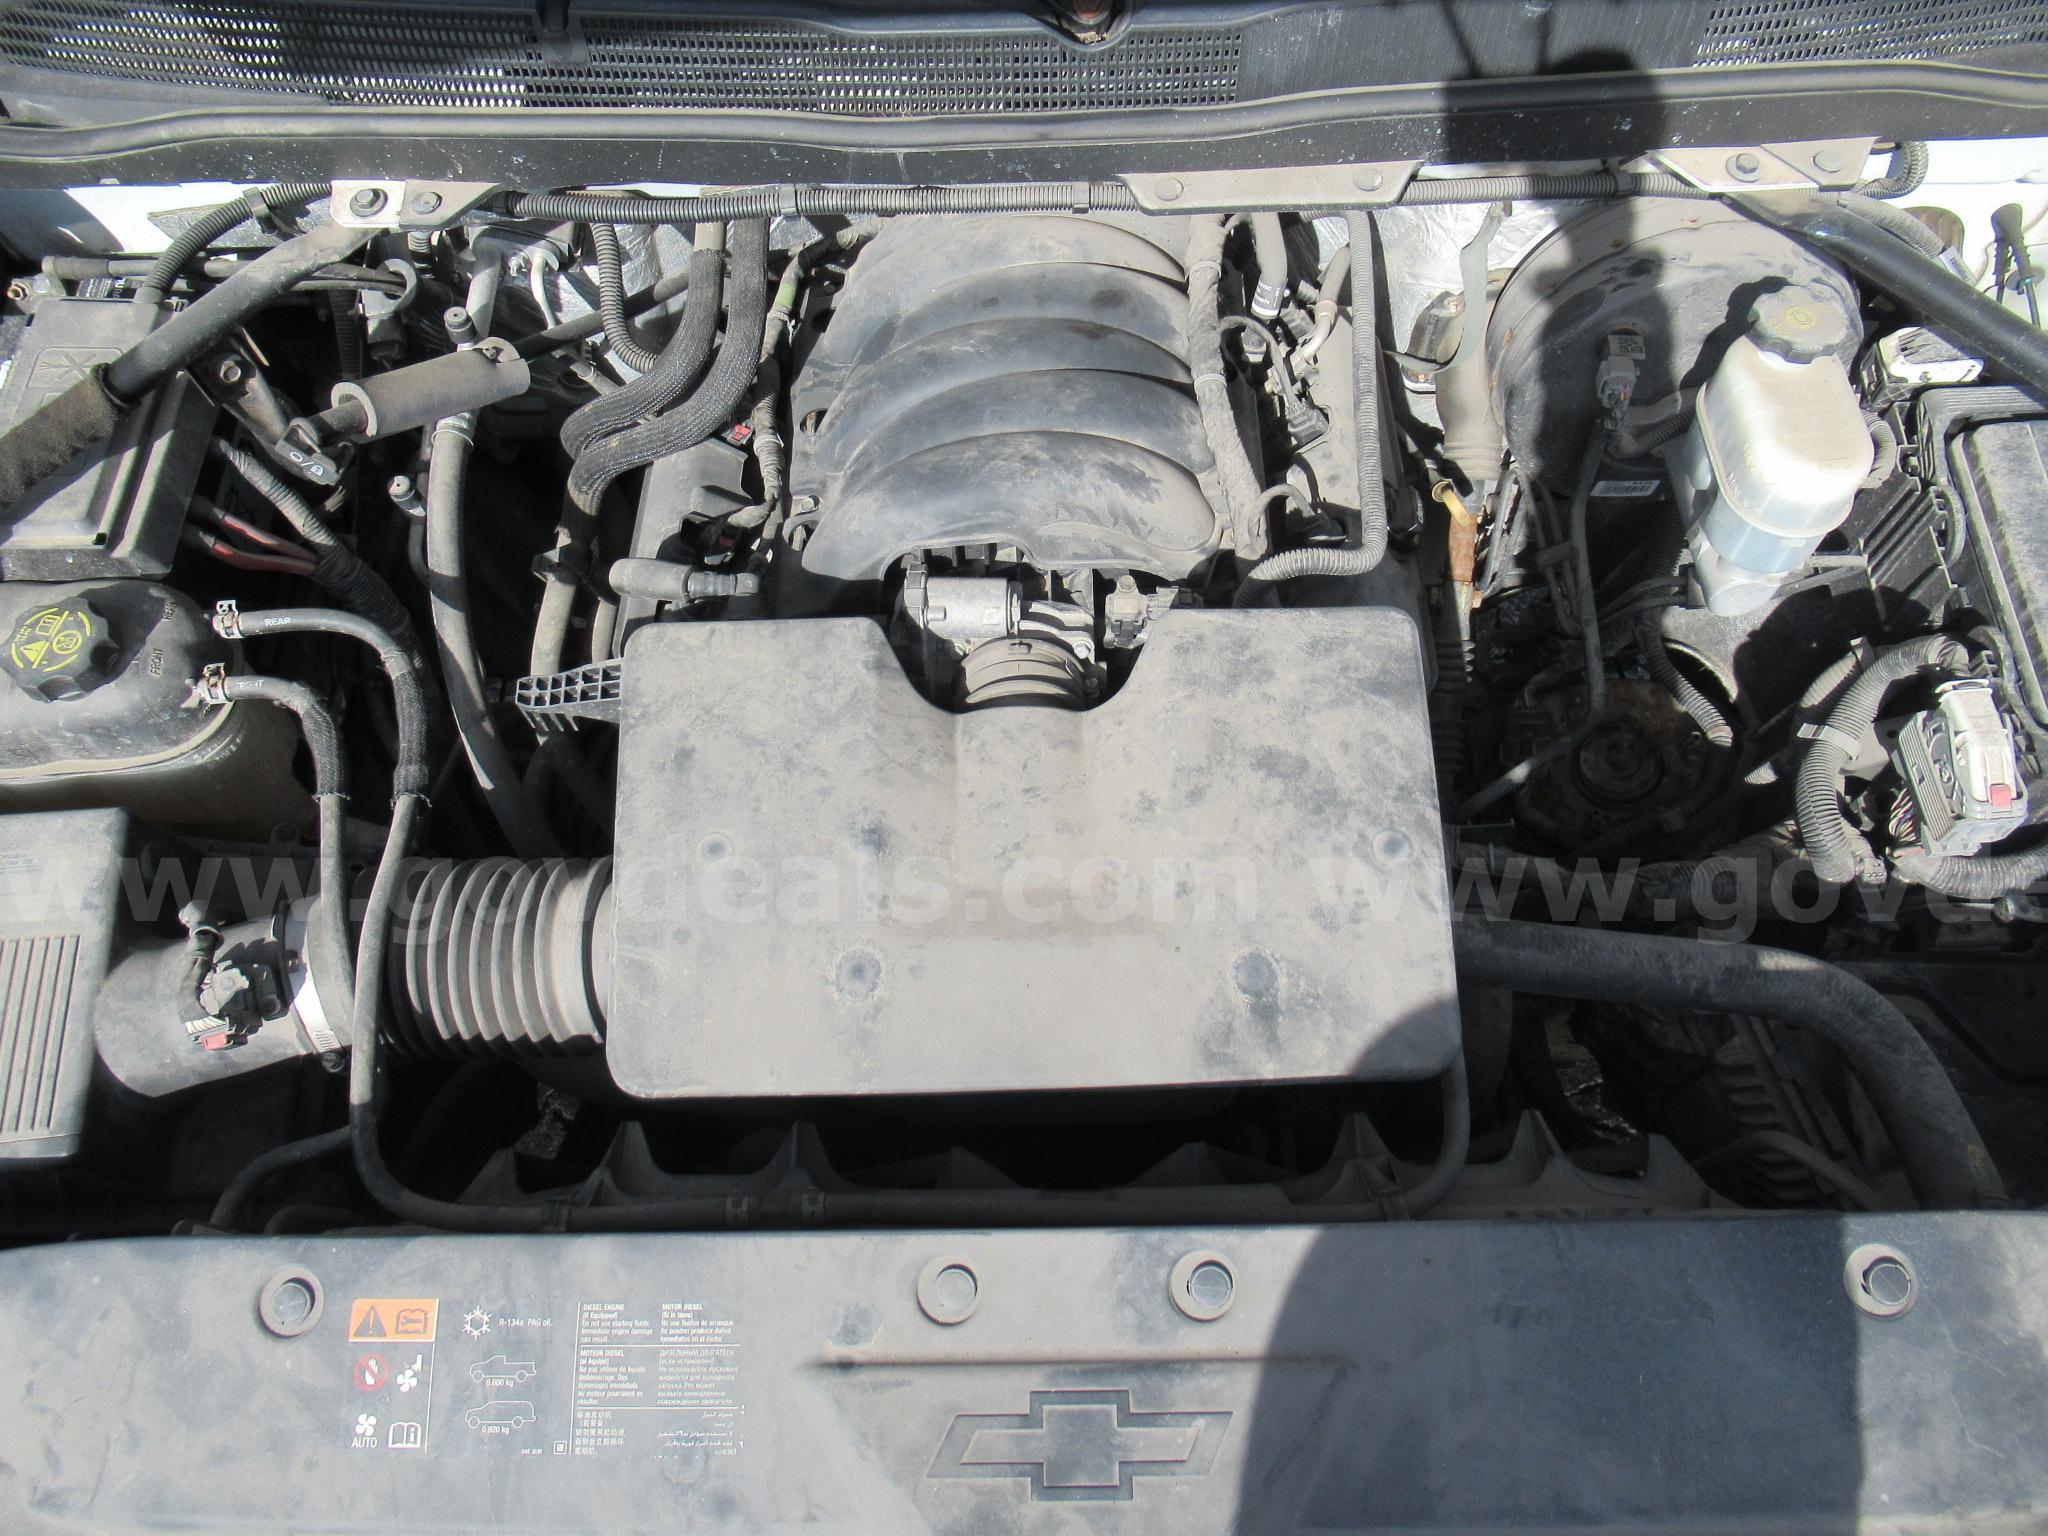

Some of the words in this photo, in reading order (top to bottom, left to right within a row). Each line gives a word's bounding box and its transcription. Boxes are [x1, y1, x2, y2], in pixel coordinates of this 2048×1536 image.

[264, 616, 293, 627] REAR
[150, 648, 163, 676] FRONT
[506, 1379, 514, 1388] kg
[482, 1426, 500, 1434] 0.920
[502, 1426, 510, 1435] kg
[352, 1437, 378, 1448] AUTO
